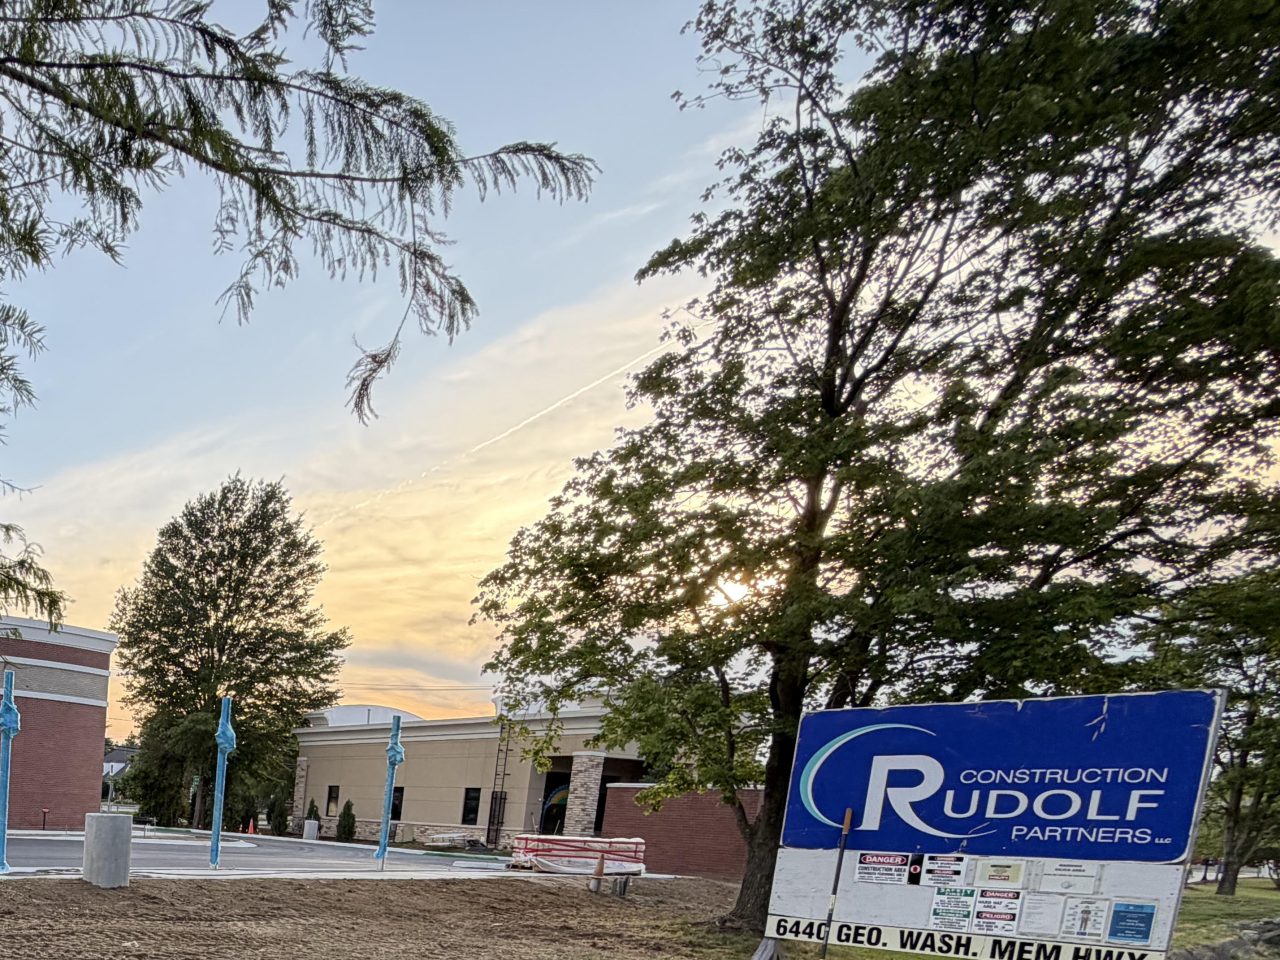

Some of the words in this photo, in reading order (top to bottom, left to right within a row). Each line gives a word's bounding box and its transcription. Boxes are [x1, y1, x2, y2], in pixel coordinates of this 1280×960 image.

[959, 767, 1169, 784] CONSTRUCTION
[857, 755, 1166, 838] RUDOLF
[1011, 825, 1152, 844] PARTNERS
[865, 856, 902, 864] DANGER
[836, 924, 888, 948] GEO.
[899, 930, 978, 957] WASH.
